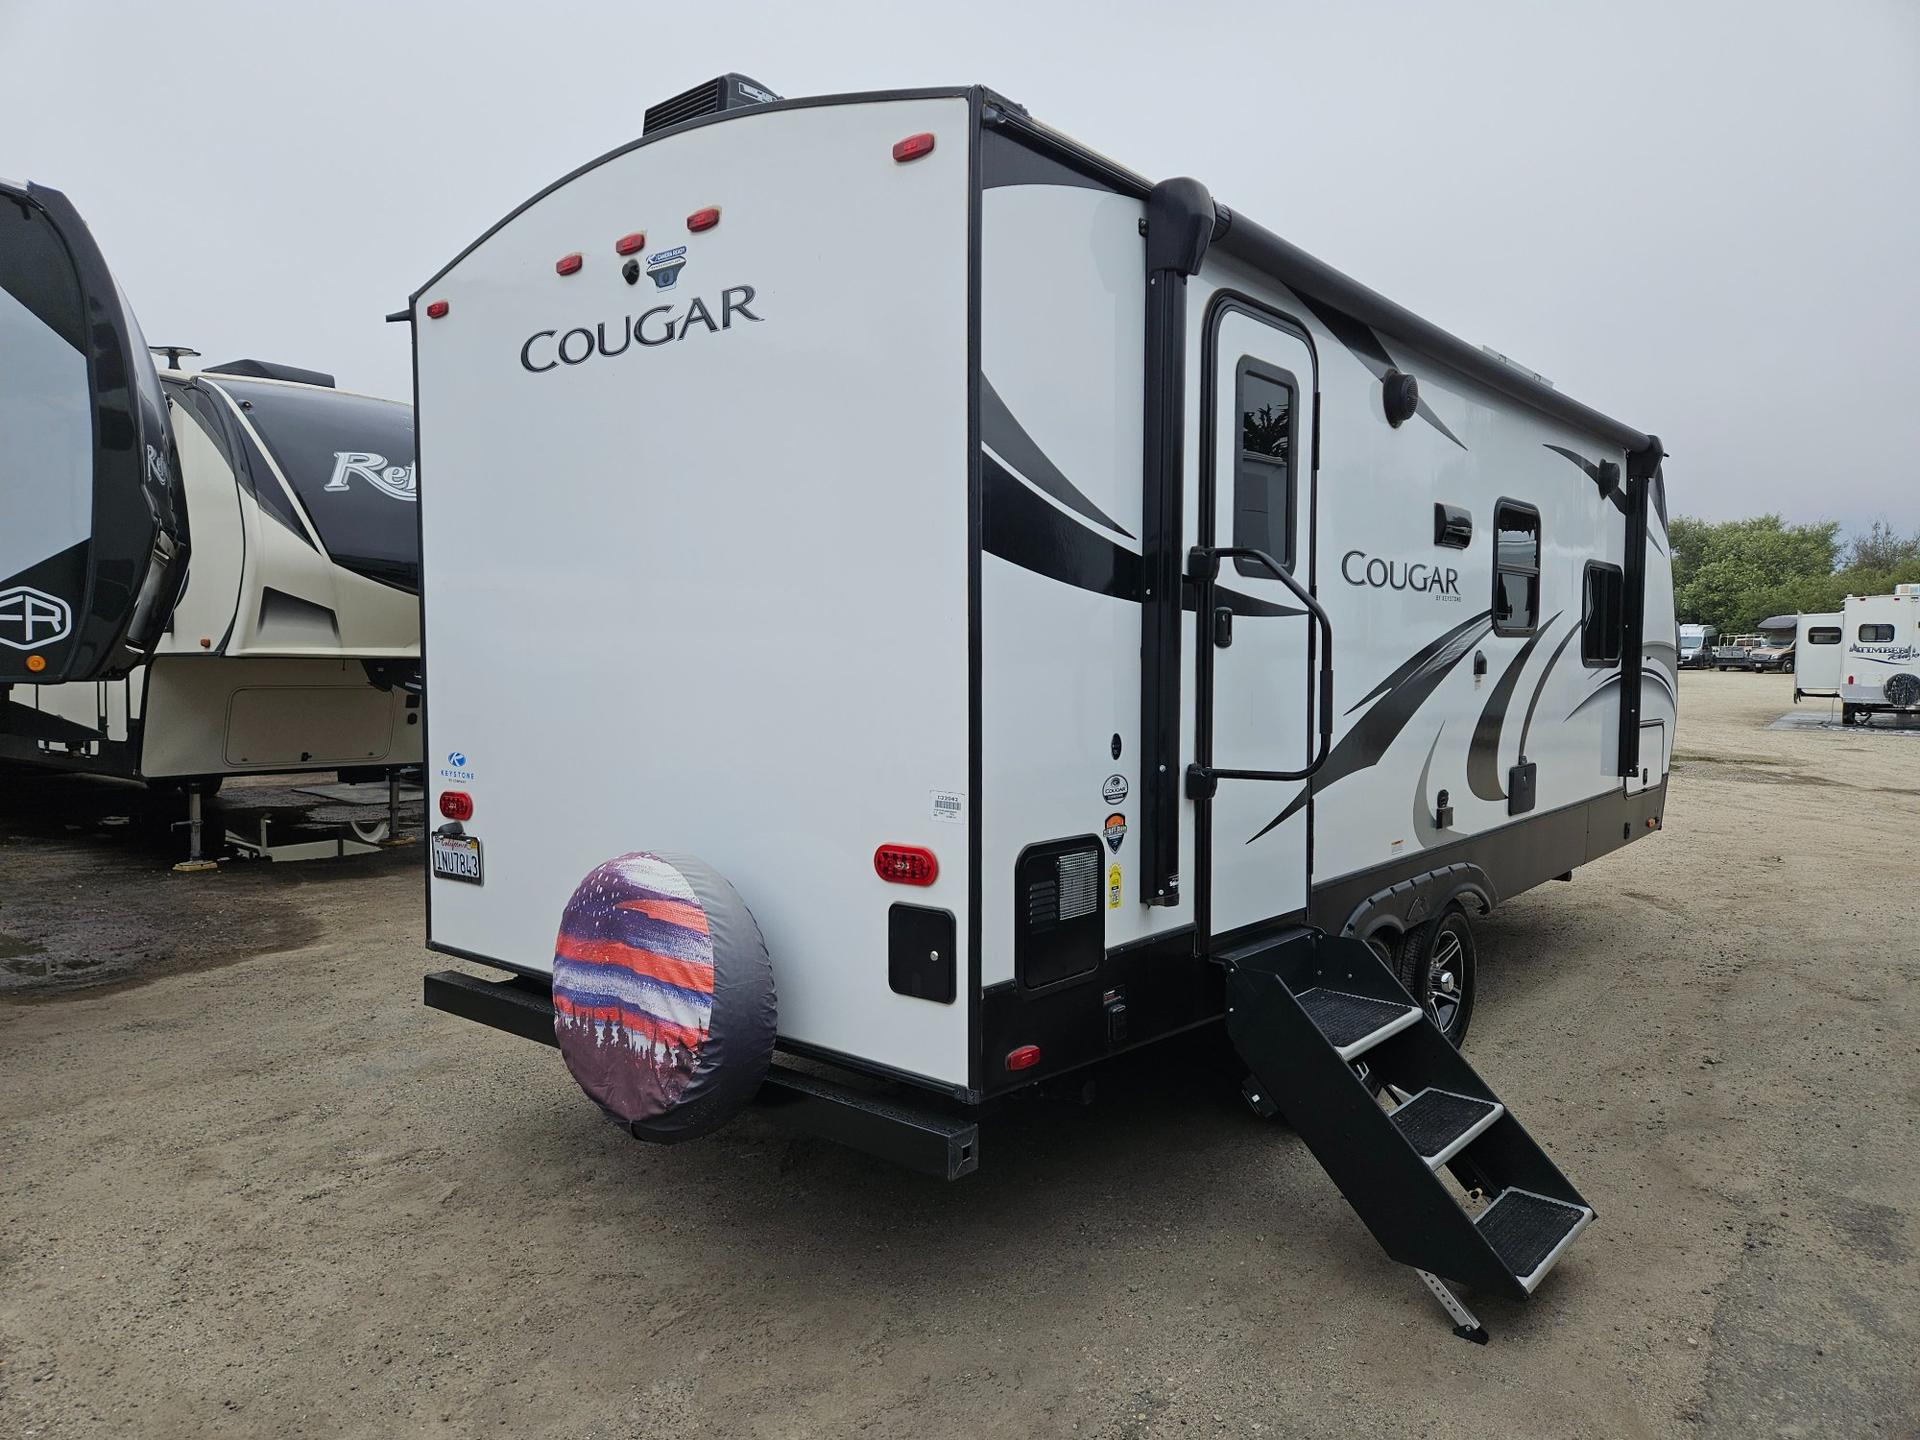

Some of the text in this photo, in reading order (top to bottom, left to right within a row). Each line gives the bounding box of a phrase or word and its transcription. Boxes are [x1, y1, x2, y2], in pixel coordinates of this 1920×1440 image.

[520, 284, 765, 373] COUGAR
[1341, 550, 1461, 595] COUGAR
[441, 770, 475, 779] KEYSTONE
[437, 850, 477, 876] 1NU7843
